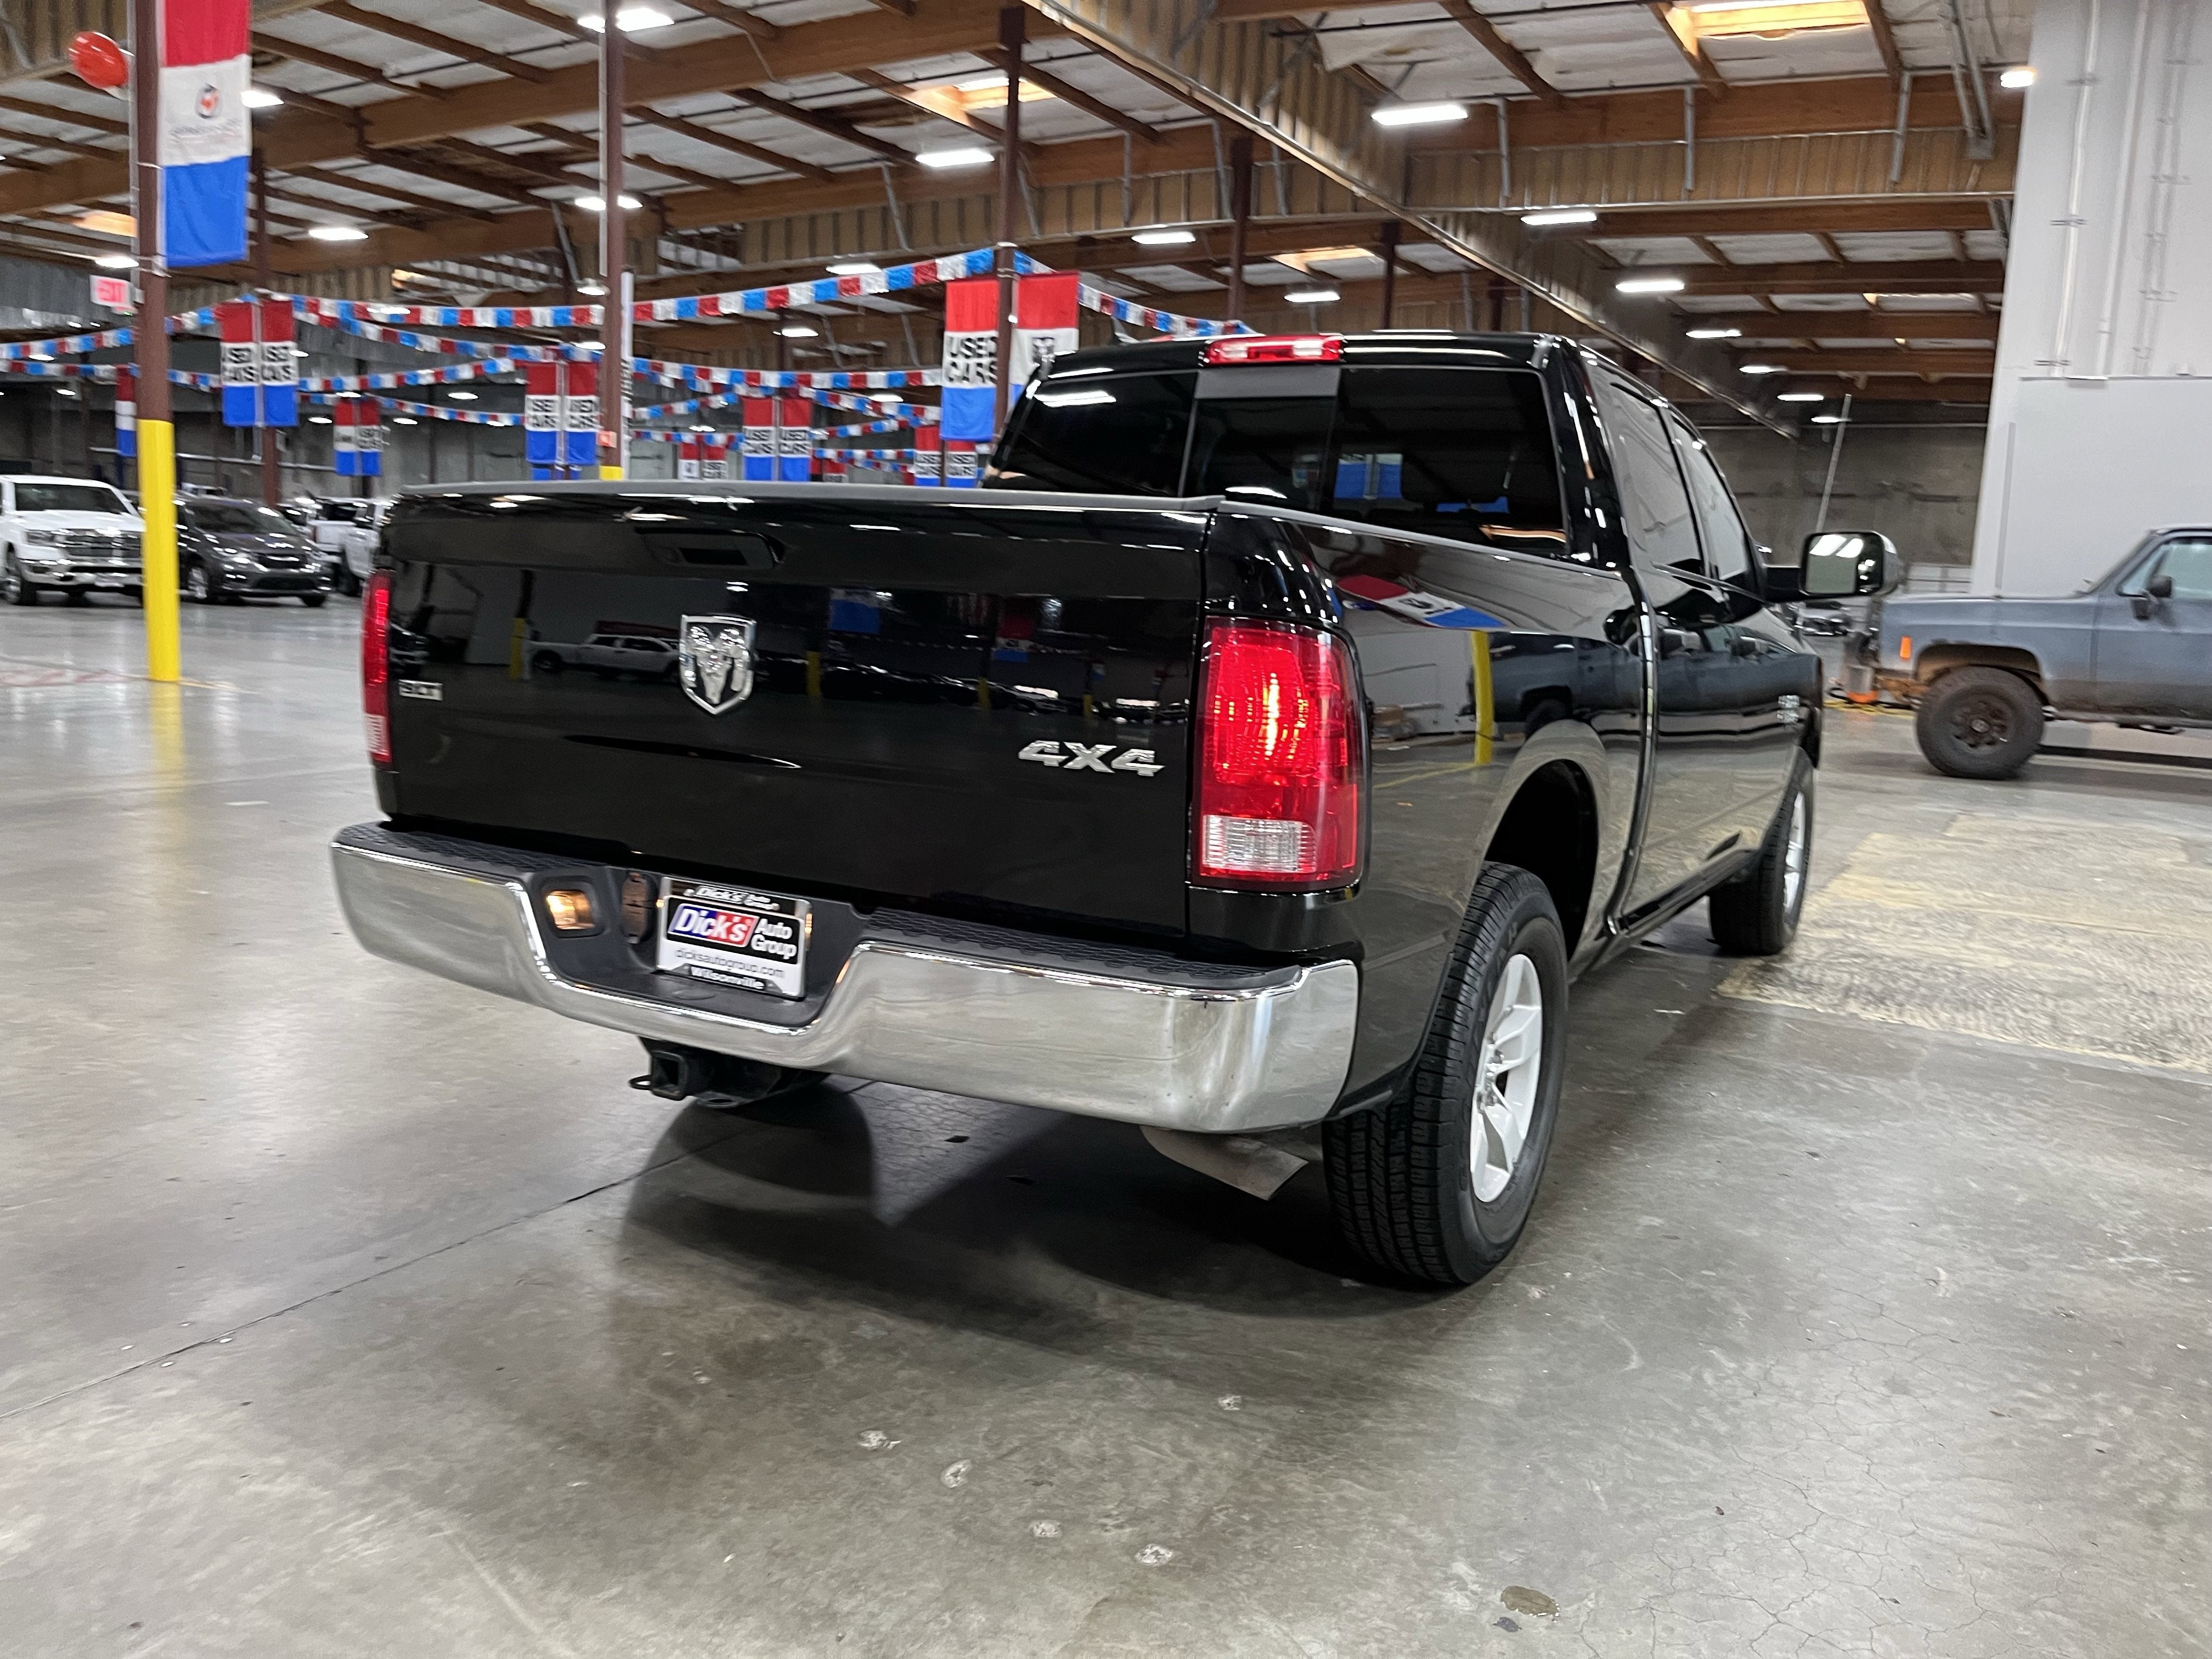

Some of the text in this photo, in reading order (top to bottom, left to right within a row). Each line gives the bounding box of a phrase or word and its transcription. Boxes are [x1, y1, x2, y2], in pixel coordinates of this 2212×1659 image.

[949, 336, 997, 358] USED
[947, 360, 997, 383] CARS
[675, 908, 748, 942] Dick's
[754, 918, 793, 940] Auto
[751, 934, 798, 960] Group
[675, 947, 785, 978] dicksautogroup.com
[690, 966, 765, 990] Wilsonville
